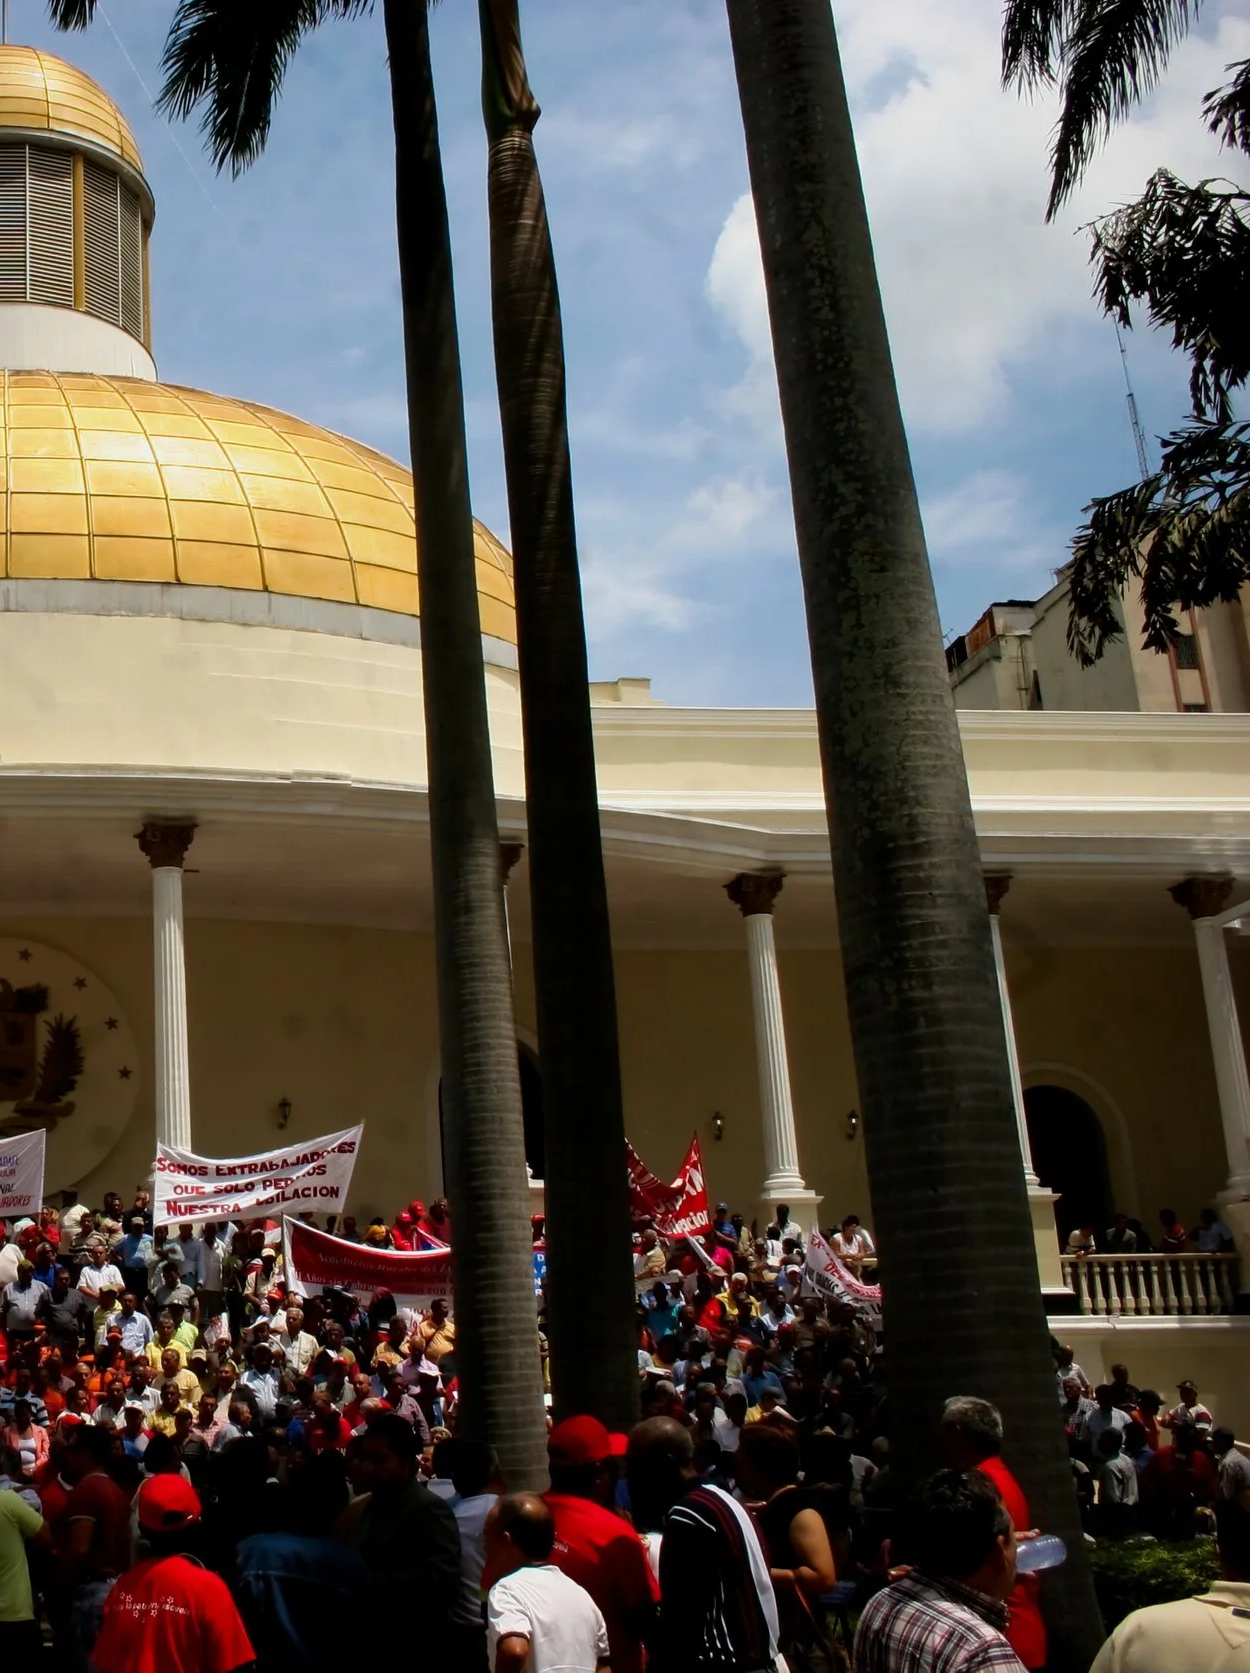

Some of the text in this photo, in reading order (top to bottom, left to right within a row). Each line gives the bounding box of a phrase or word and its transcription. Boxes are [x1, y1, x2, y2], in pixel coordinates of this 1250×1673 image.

[157, 1157, 208, 1176] SOMOS
[173, 1184, 206, 1196] QUE
[214, 1182, 256, 1194] SOLO
[166, 1200, 242, 1216] NUESTRA
